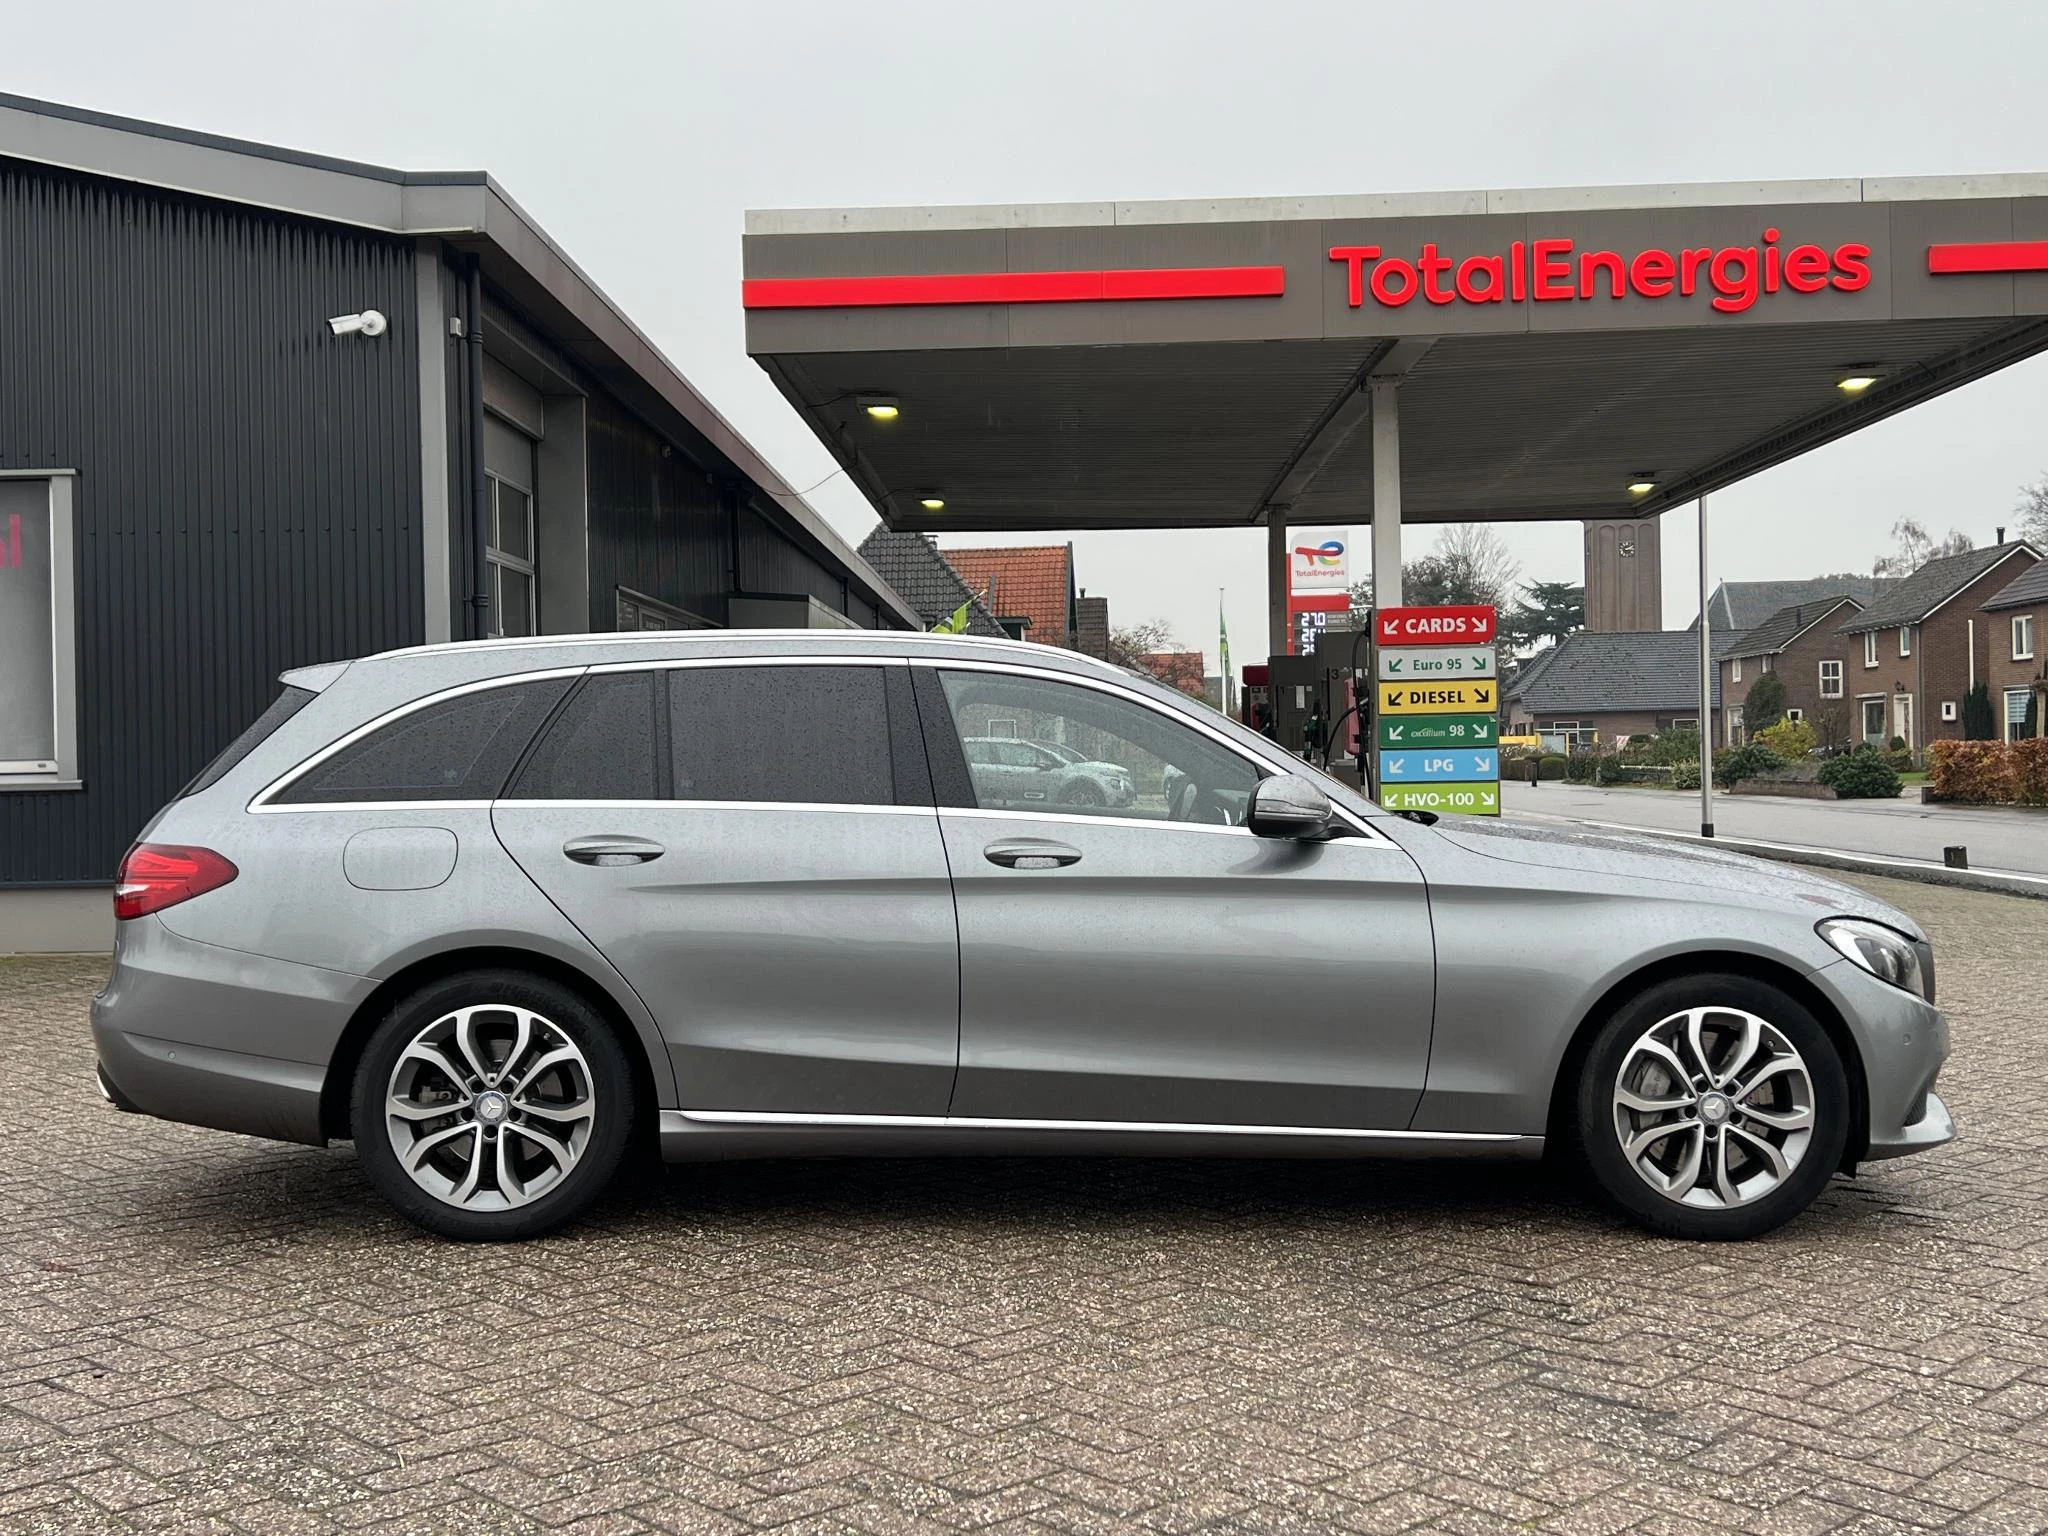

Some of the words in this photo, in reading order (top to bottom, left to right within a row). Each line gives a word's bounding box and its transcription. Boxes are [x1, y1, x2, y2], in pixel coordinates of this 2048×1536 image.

[1329, 227, 1872, 313] TotalEnergies
[1295, 569, 1345, 577] TotalEnergies
[1405, 617, 1467, 634] CARDS
[1413, 659, 1443, 671] Euro
[1446, 658, 1462, 670] 95
[1410, 691, 1466, 704] DIESEL
[1448, 724, 1466, 737] 98
[1424, 758, 1455, 773] LPG
[1403, 792, 1475, 807] HVO-100
